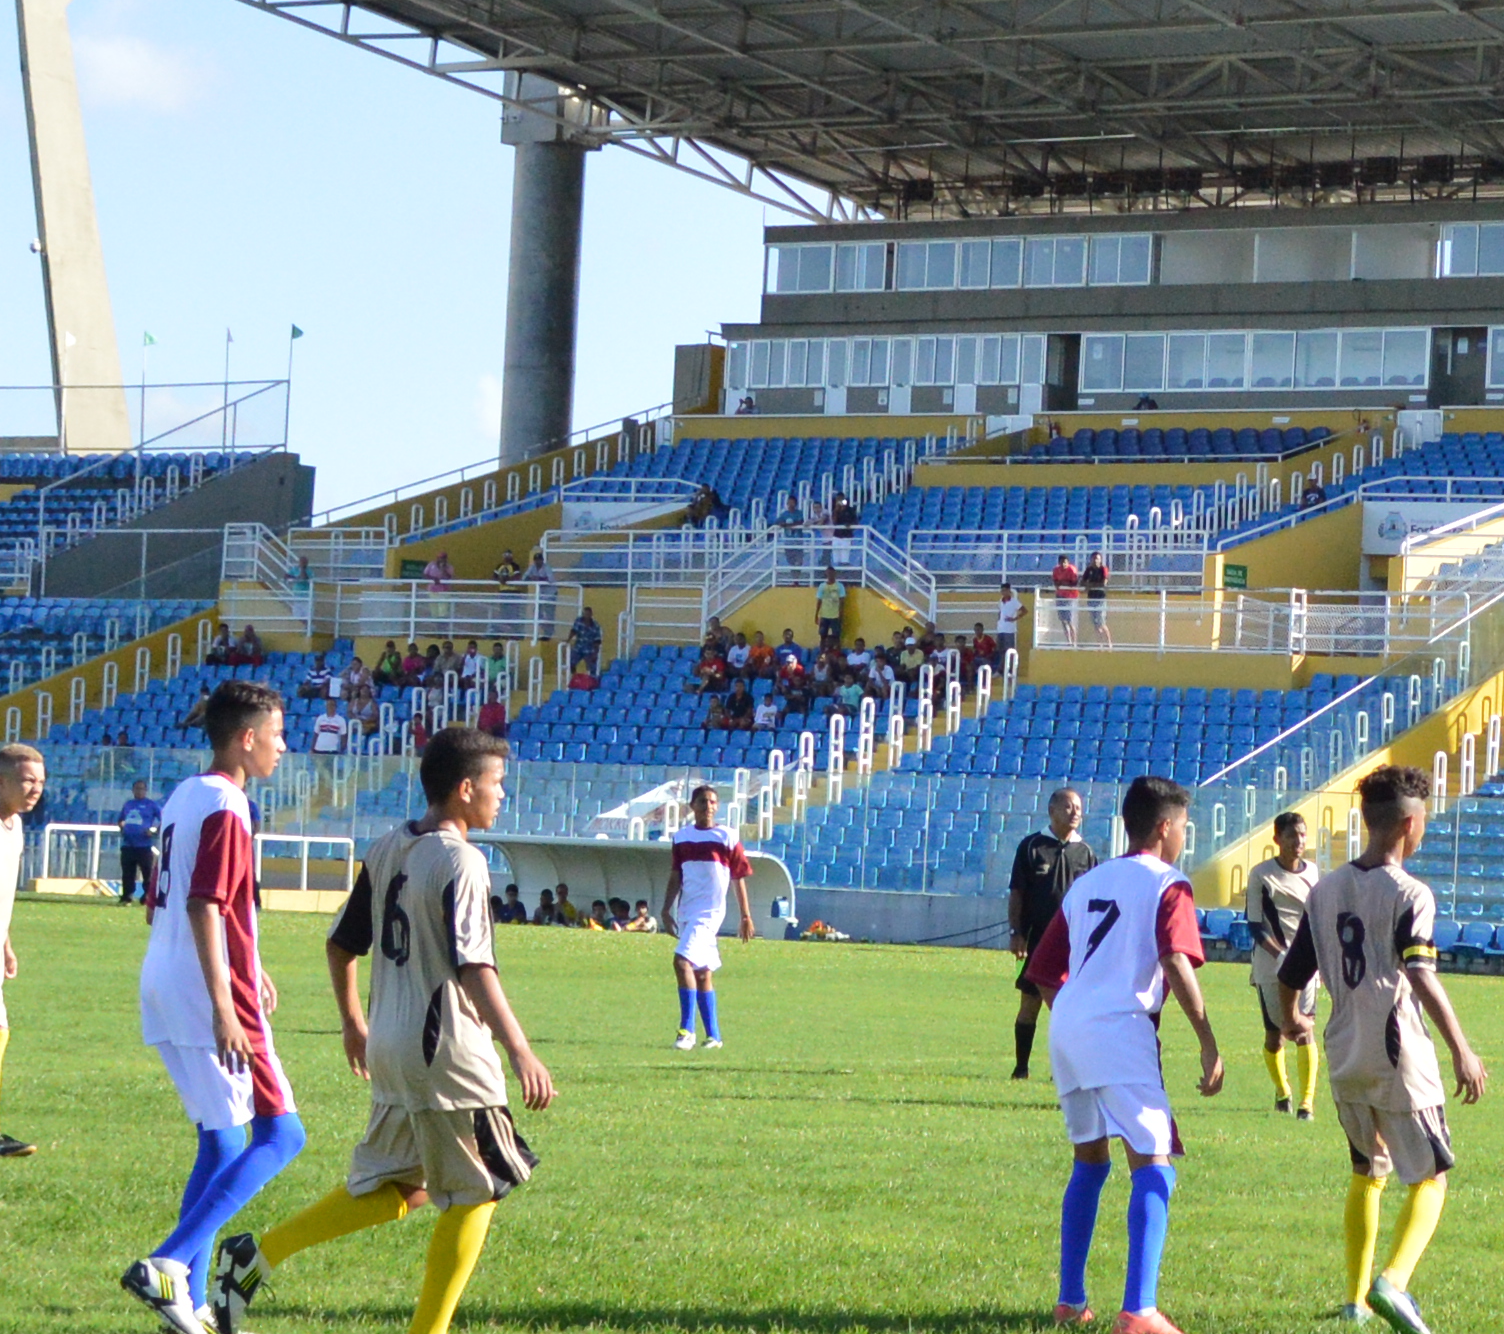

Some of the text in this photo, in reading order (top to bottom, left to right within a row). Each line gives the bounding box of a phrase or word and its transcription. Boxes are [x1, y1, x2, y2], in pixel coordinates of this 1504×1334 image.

[380, 870, 410, 967] 6
[1076, 898, 1121, 979] 7
[1336, 911, 1367, 991] 8
